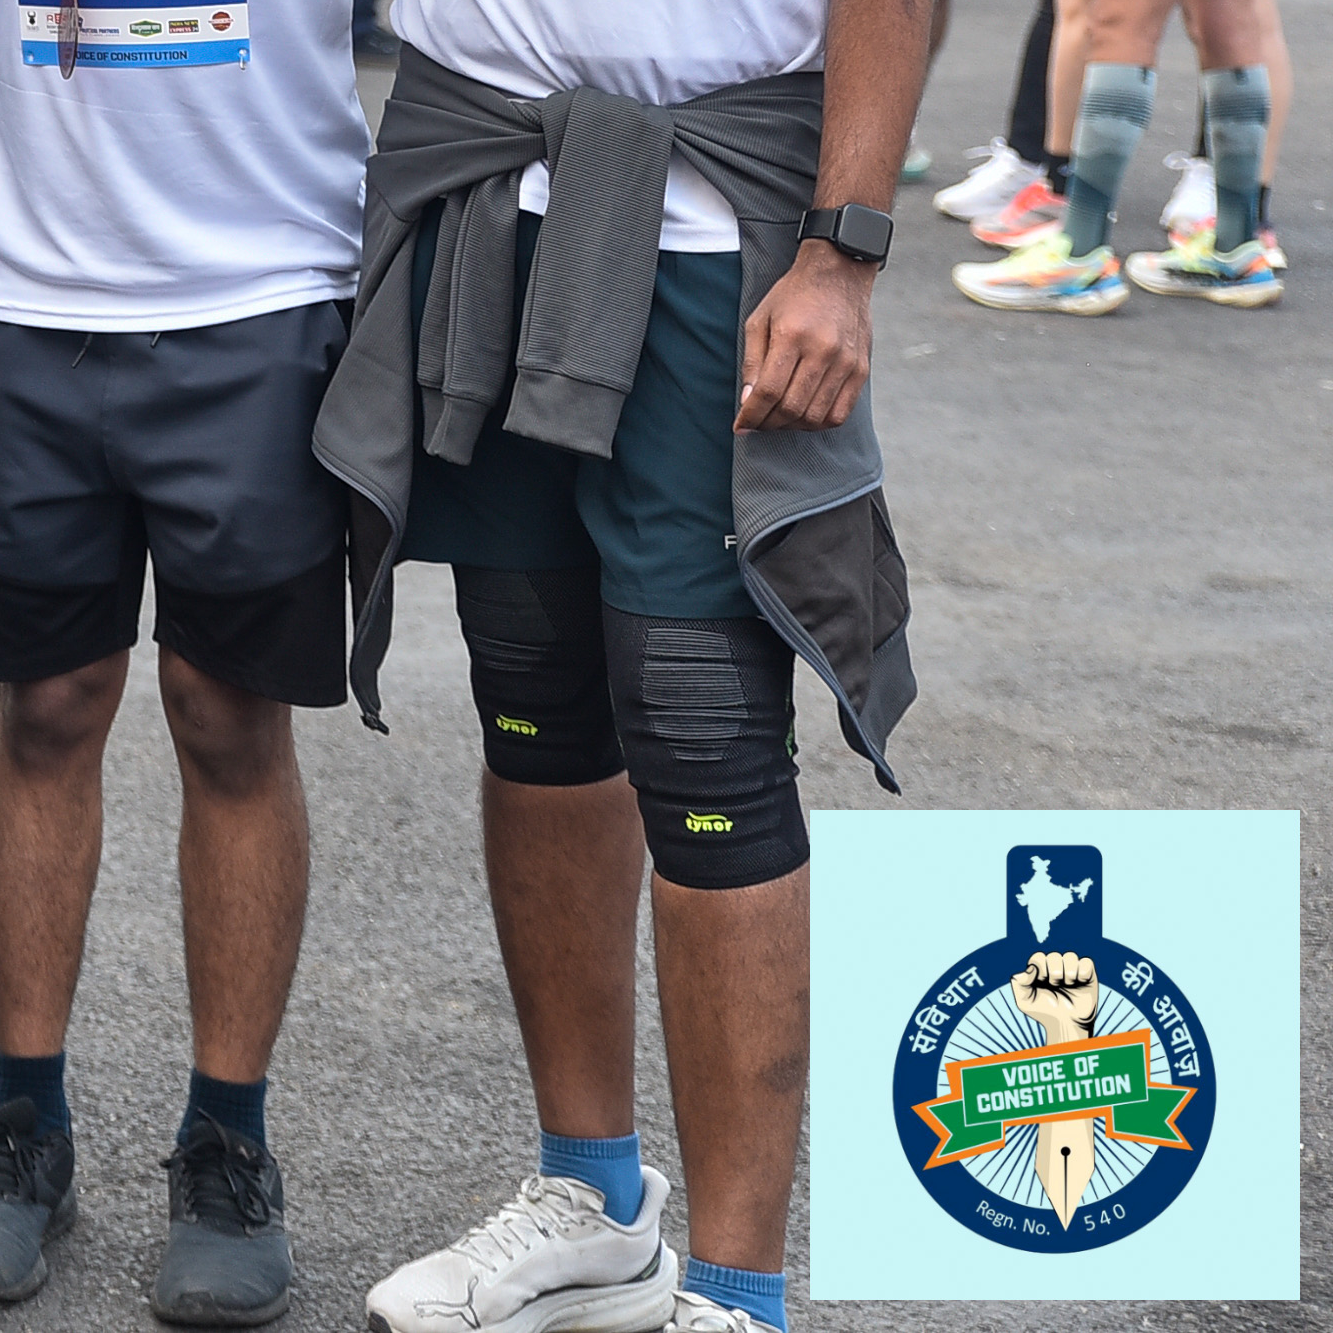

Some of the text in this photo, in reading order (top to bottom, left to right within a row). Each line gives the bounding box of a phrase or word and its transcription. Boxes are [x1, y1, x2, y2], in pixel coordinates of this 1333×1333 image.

[99, 50, 188, 62] OF CONSTITUTION
[496, 716, 538, 737] tynor
[685, 815, 734, 833] tynor
